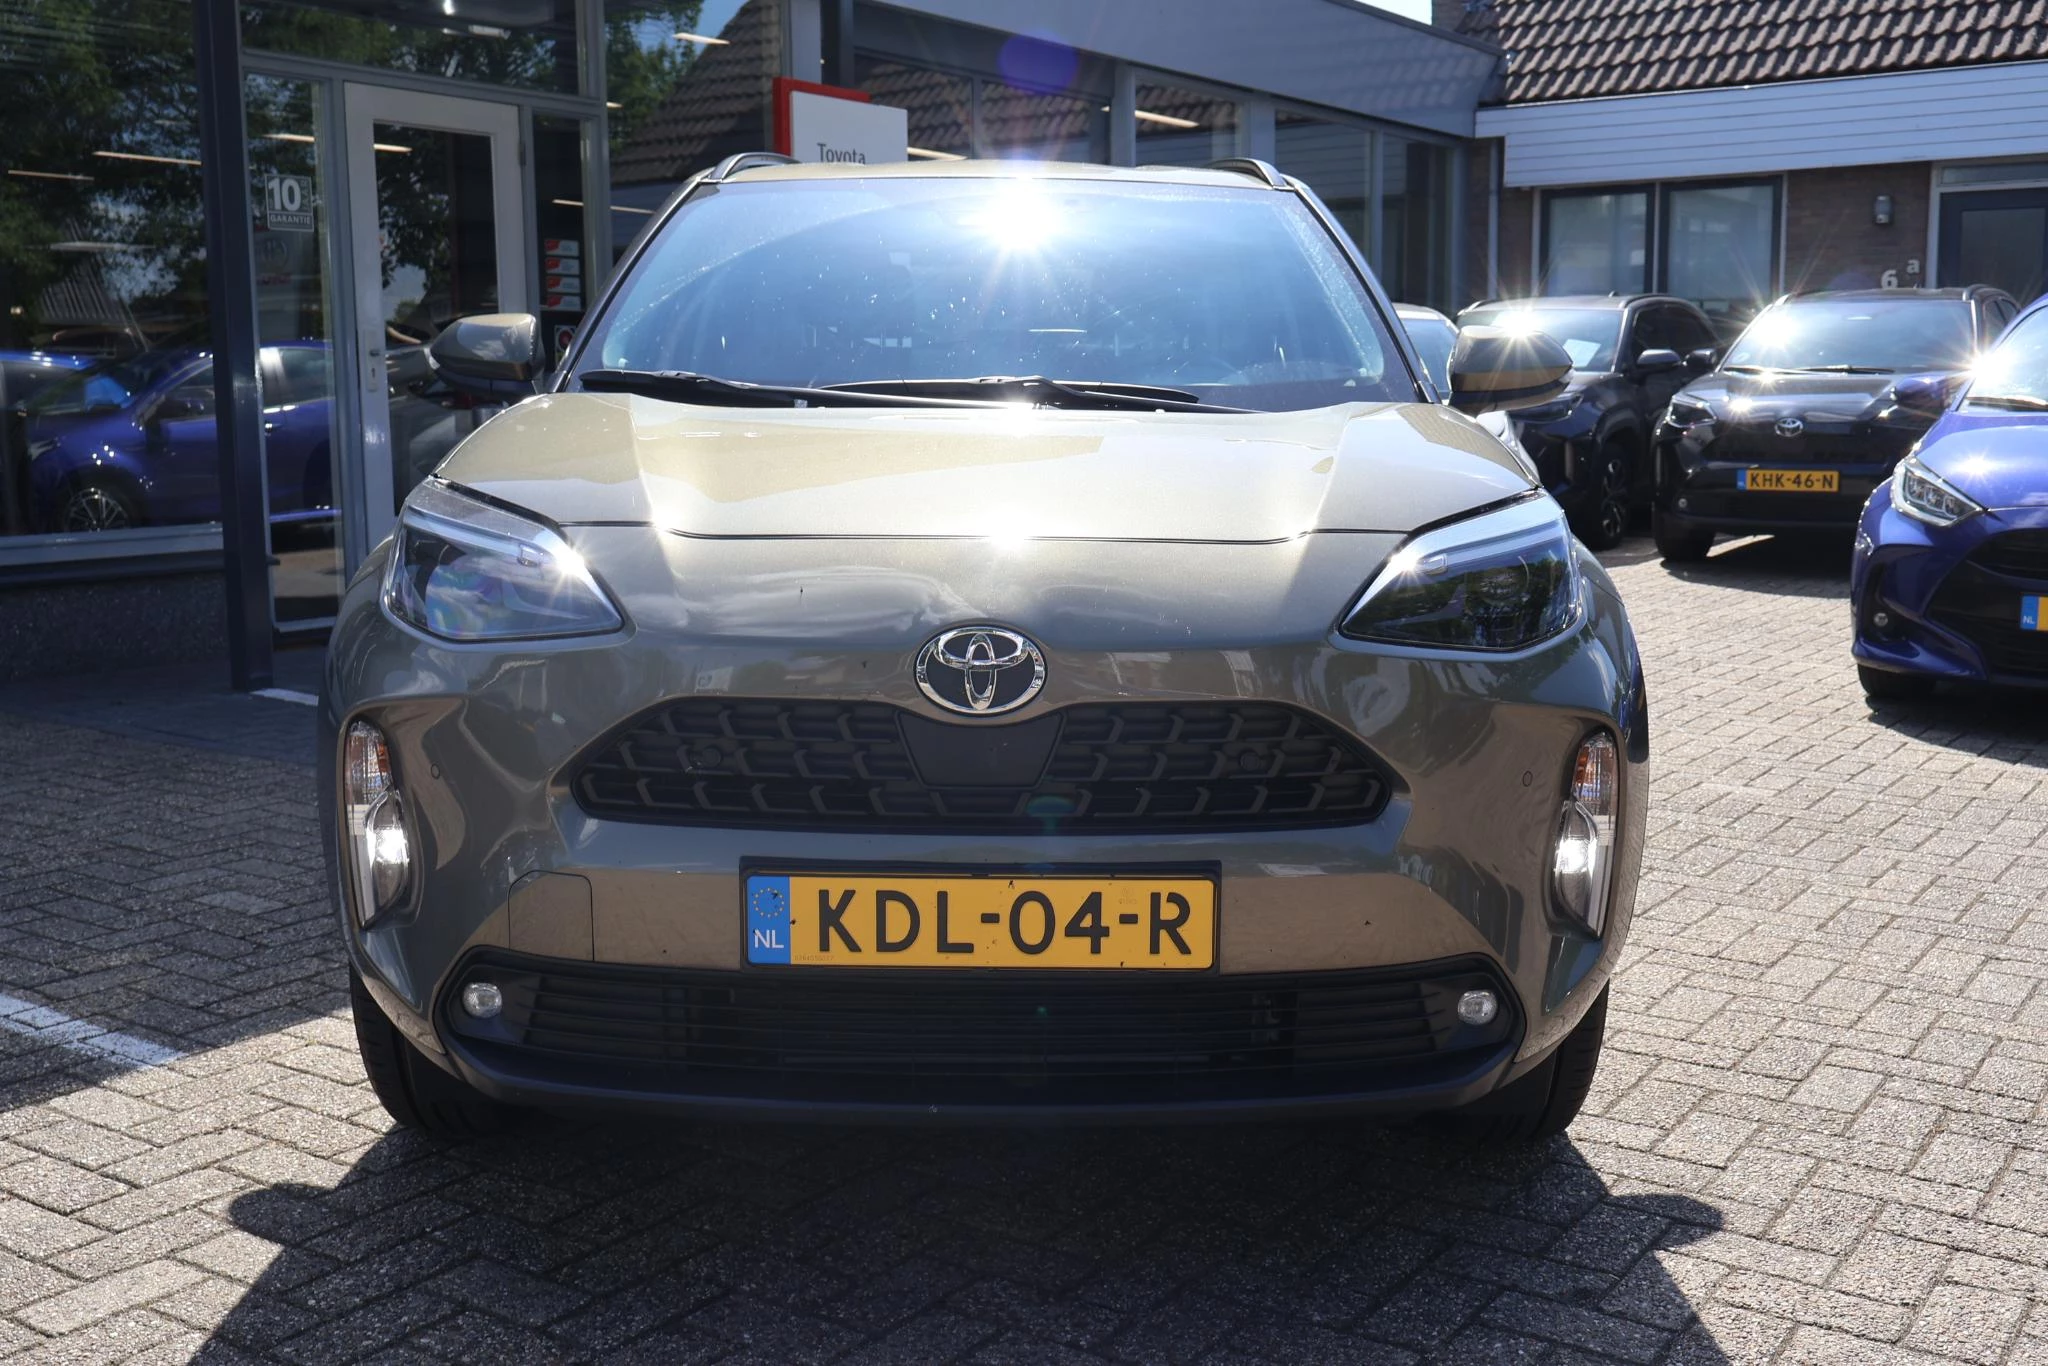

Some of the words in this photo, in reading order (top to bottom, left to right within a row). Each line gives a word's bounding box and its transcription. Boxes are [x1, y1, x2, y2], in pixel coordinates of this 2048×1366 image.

[816, 142, 866, 165] Toyota
[268, 178, 301, 211] 10
[270, 214, 311, 225] GARANTIE
[1749, 472, 1834, 489] KHK-46-N
[2022, 615, 2035, 625] NL
[753, 928, 785, 950] NL
[818, 888, 1192, 955] KDL-04-R
